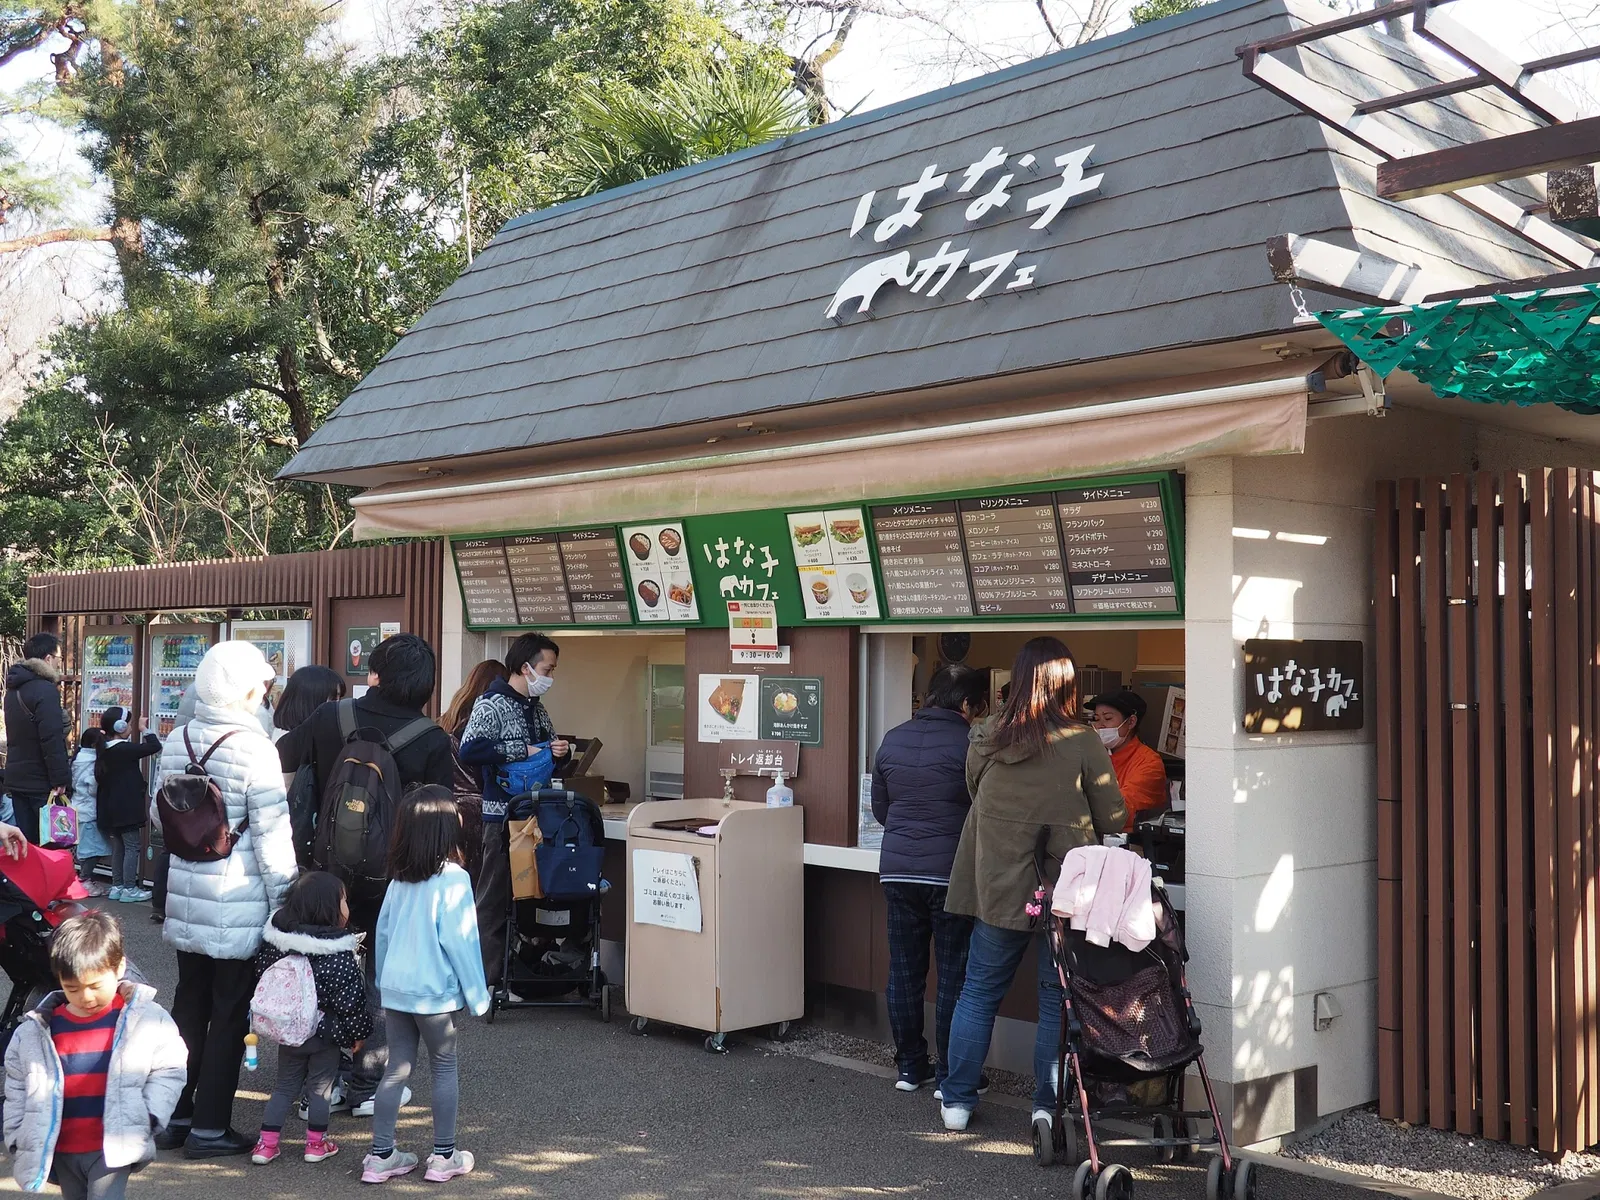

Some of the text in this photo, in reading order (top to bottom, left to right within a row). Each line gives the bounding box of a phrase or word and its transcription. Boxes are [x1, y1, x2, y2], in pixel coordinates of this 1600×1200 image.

[850, 144, 1105, 243] はな子
[910, 241, 1037, 301] カフェ
[1082, 489, 1131, 500] サイドメニュー
[980, 498, 1030, 508] ドリンクメニュー
[1063, 500, 1158, 514] サラダ ¥230
[893, 506, 932, 514] メインメニュー
[966, 512, 996, 522] コカ・コーラ
[876, 518, 938, 528] ベーコンとタマゴのサンドイッチ
[968, 522, 1052, 534] メロンソーダ ¥250
[1066, 519, 1105, 529] フランクパック
[1068, 530, 1164, 542] フライドポテト ¥290
[881, 545, 902, 554] 焼きそば
[1042, 549, 1057, 557] ¥280
[1070, 547, 1115, 556] クラムチャウダー
[703, 536, 780, 578] はな子
[884, 558, 924, 566] 焼きおにぎり弁当
[1044, 562, 1060, 570] ¥280
[1072, 560, 1112, 568] ミネストローネ
[1092, 572, 1148, 583] デザートメニュー
[740, 575, 780, 601] カフェ
[954, 594, 968, 602] ¥720
[980, 604, 1002, 612] 生ビール
[1256, 660, 1359, 703] はな子カフェ
[730, 752, 784, 766] トレイ返却台
[652, 866, 687, 878] トレイはこちらに
